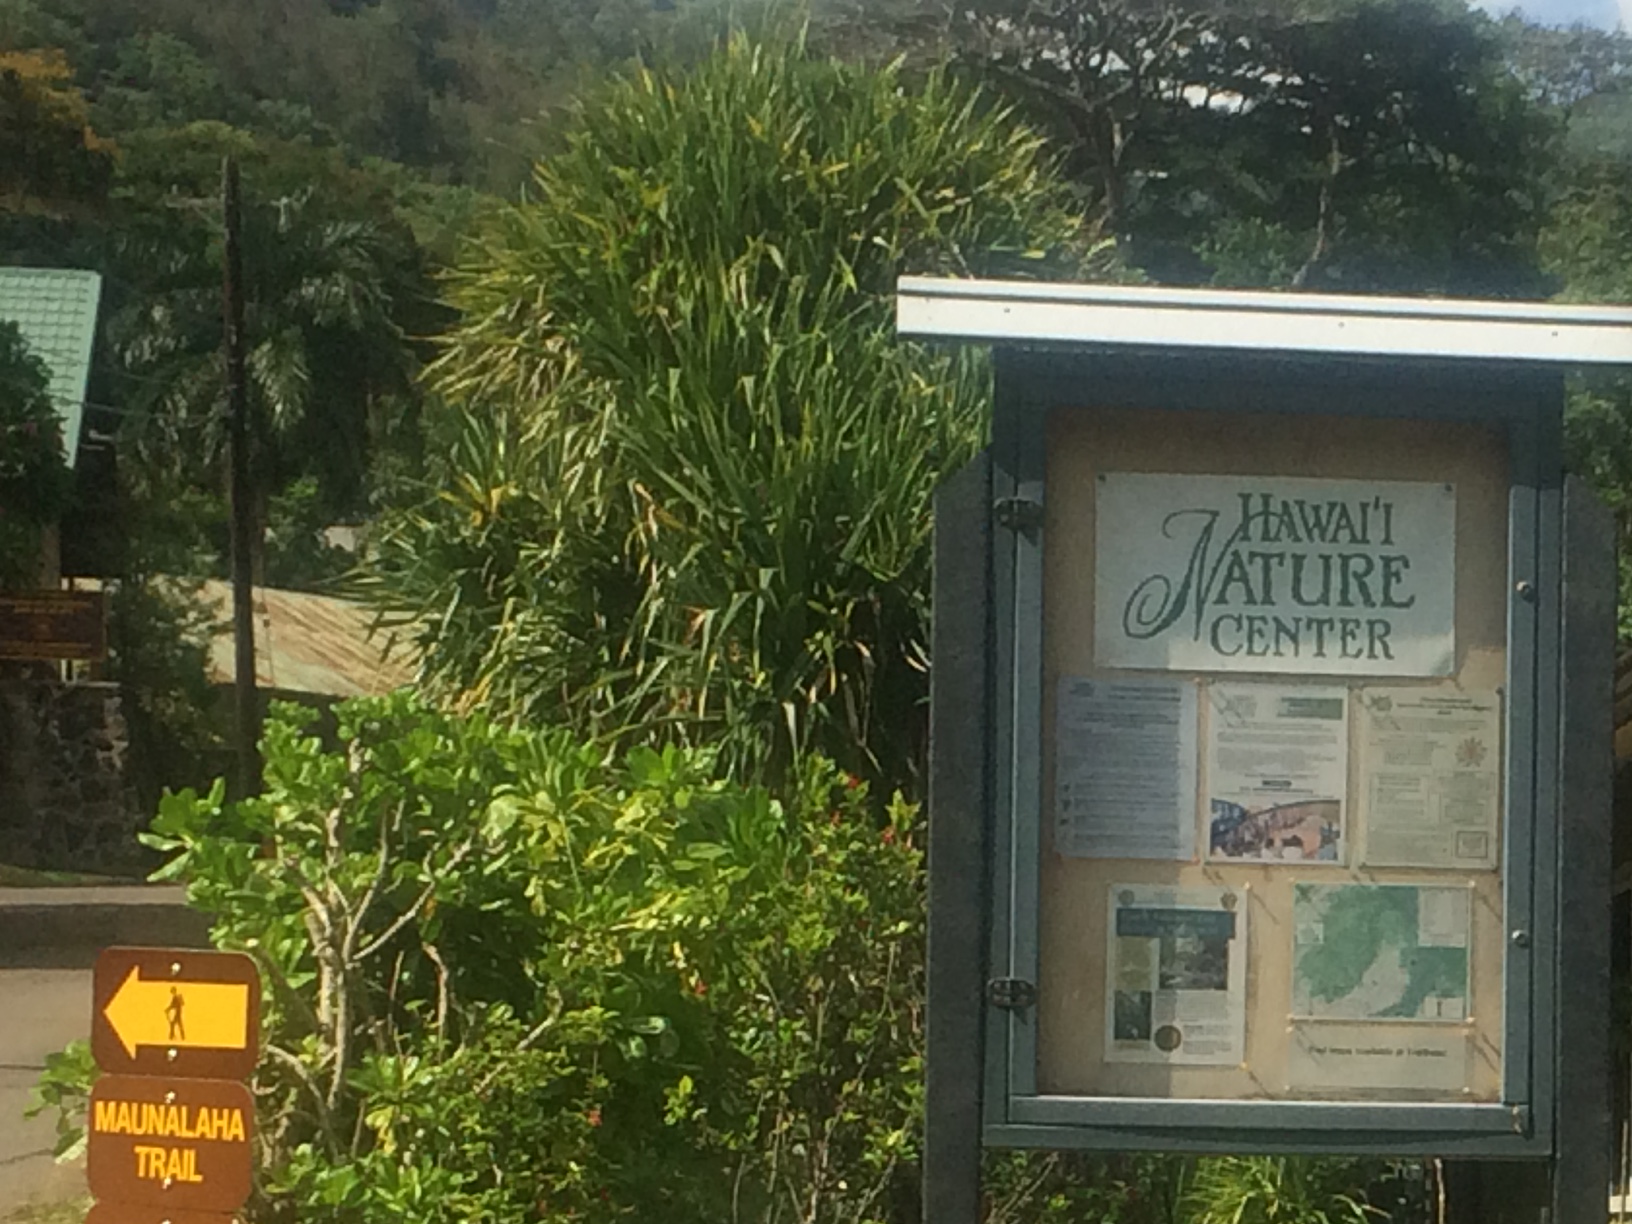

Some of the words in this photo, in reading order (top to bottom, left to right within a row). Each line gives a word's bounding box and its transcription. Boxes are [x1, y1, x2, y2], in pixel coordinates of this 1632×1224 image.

[1123, 509, 1416, 642] NATURE
[1210, 613, 1396, 660] CENTER
[95, 1101, 245, 1142] MAUNALAHA
[134, 1146, 203, 1182] TRAIL
